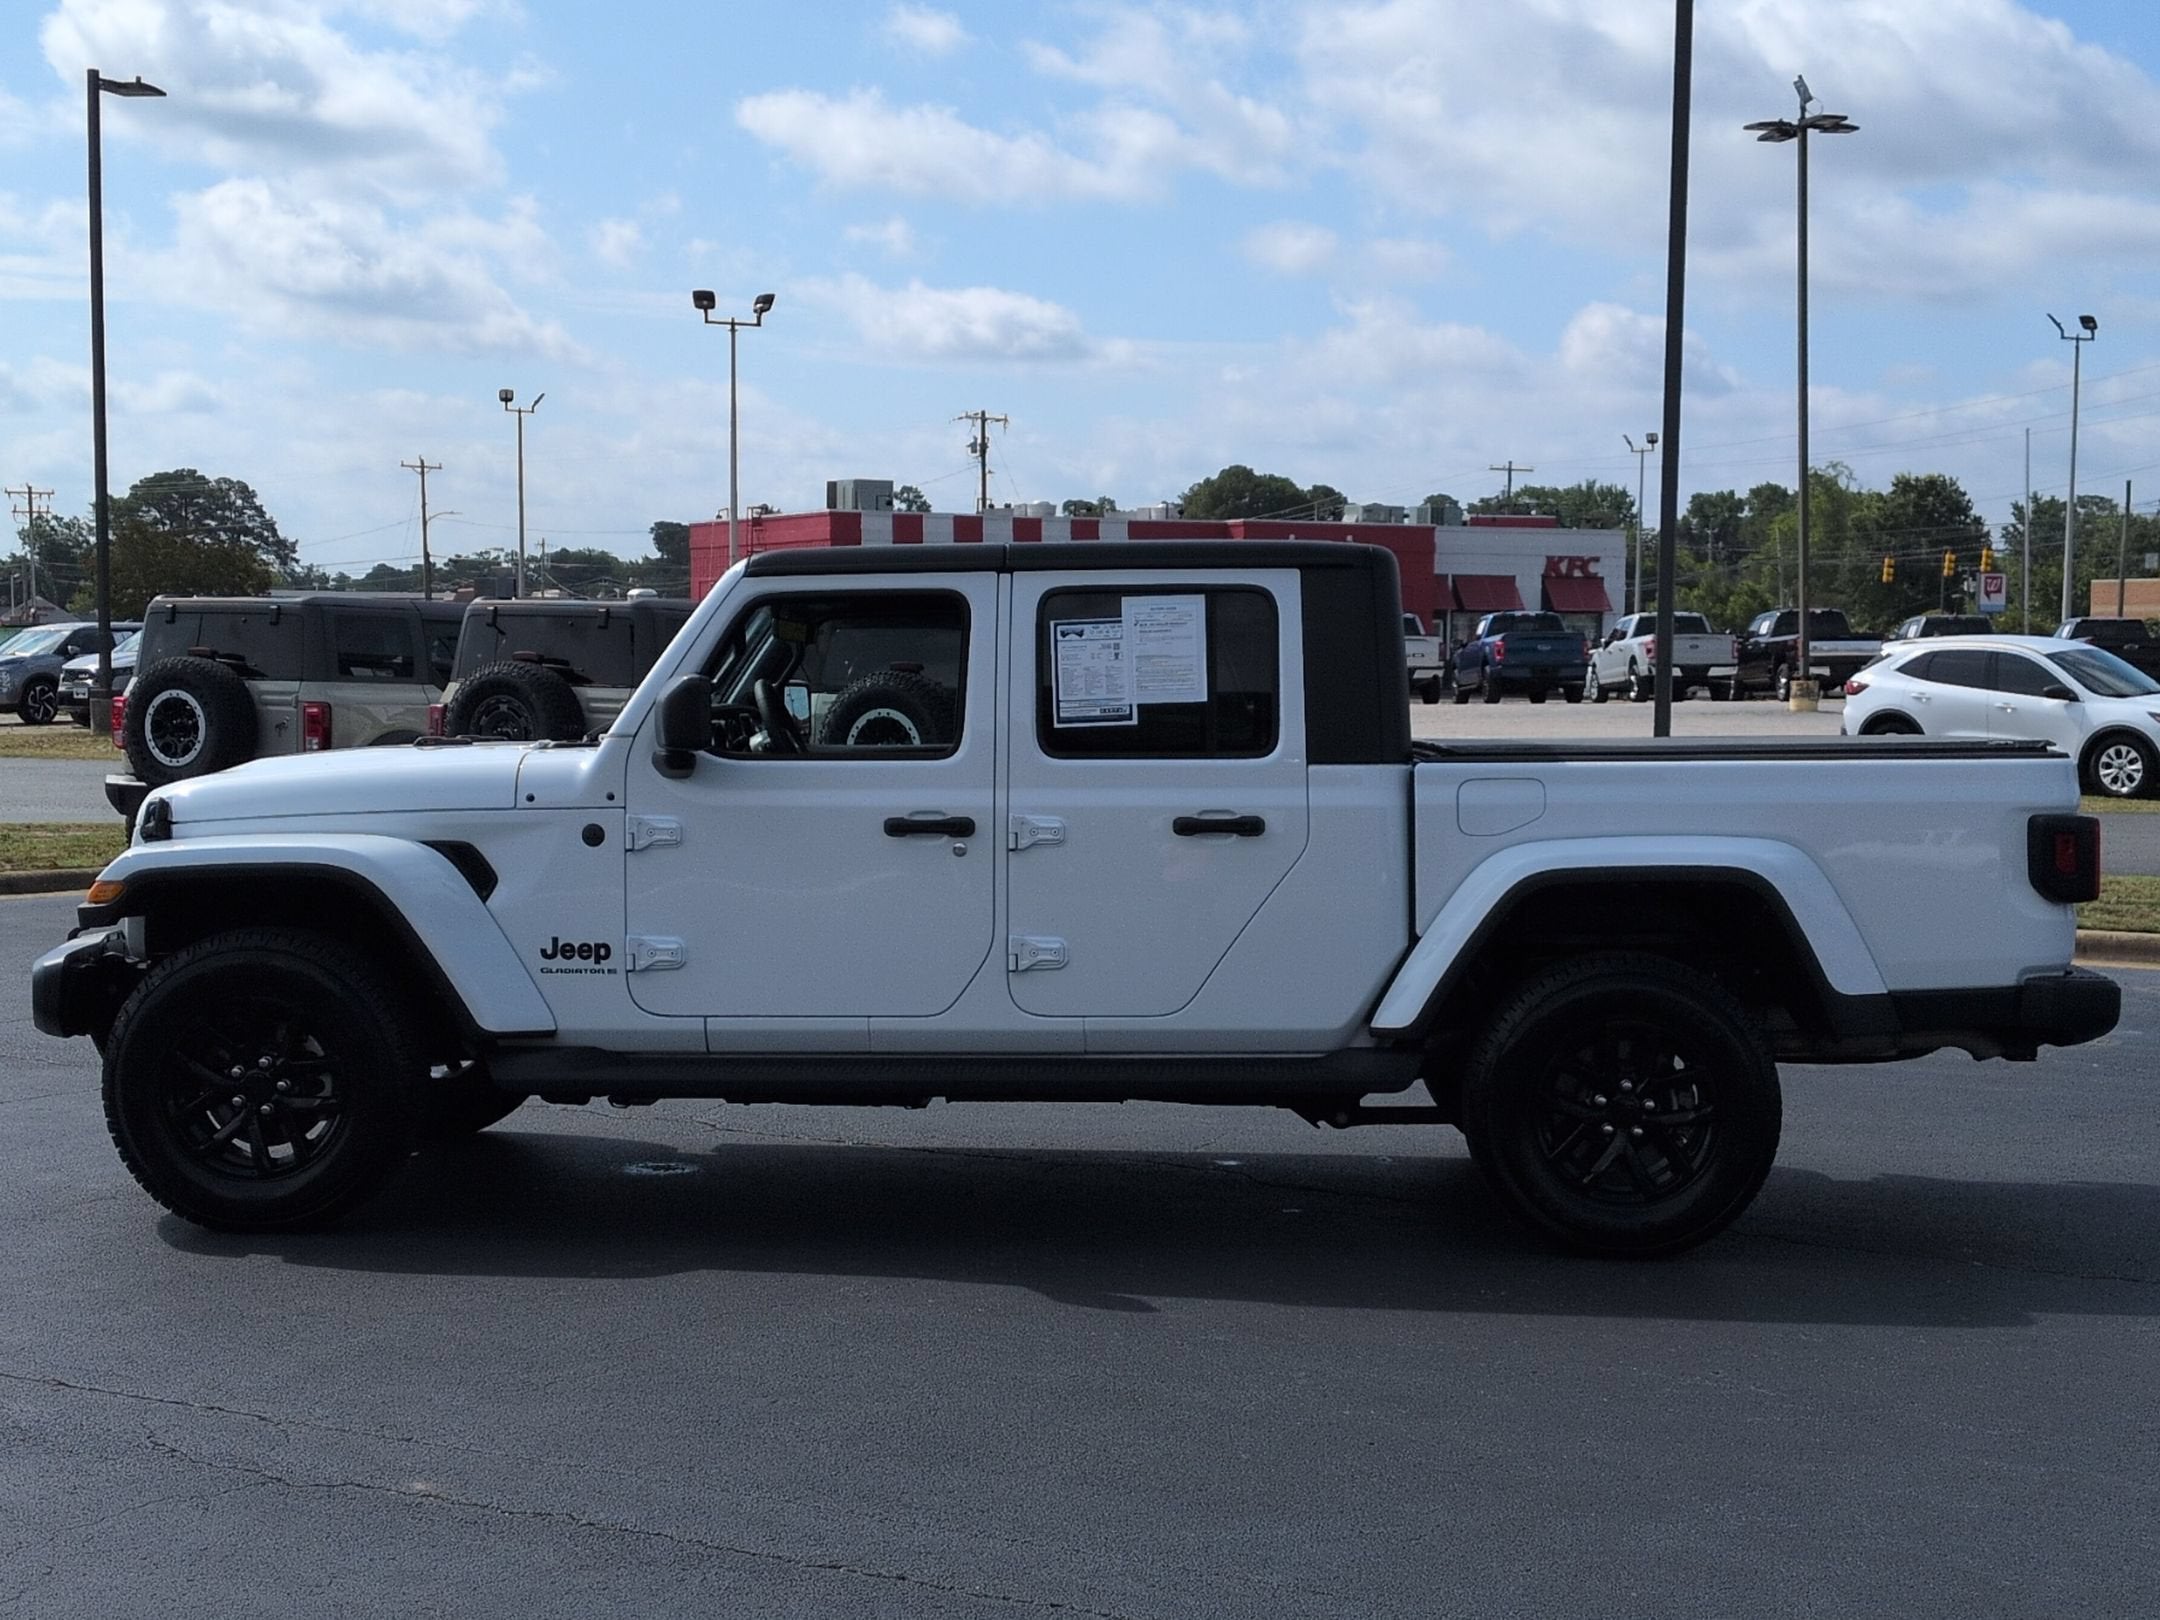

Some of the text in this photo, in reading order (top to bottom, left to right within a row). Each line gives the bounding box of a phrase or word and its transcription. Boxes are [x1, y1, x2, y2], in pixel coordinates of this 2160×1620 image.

[1544, 555, 1601, 578] KFC
[540, 936, 611, 965] Jeep
[540, 967, 605, 975] GLADIATOR
